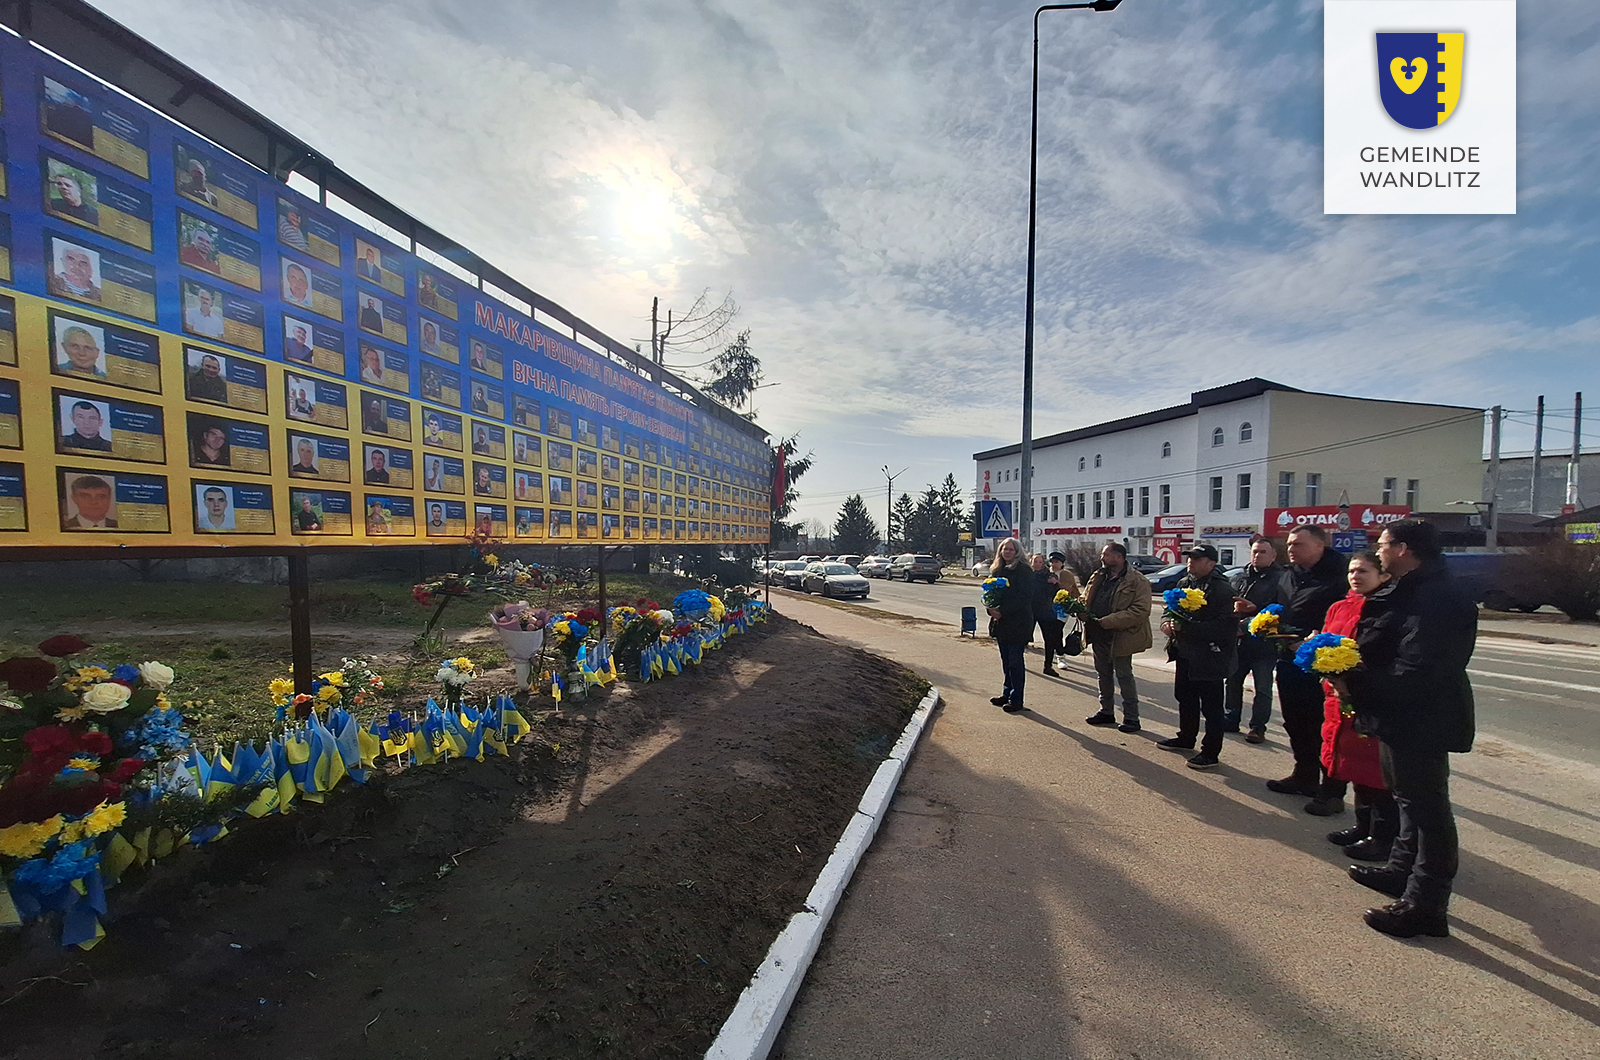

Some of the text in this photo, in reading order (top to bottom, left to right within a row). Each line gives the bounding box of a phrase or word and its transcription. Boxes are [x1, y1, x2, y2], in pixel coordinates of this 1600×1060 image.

[475, 301, 602, 381] МАКАРІВЩИНА
[513, 359, 558, 396] ВІЧНА
[1335, 537, 1351, 548] 20
